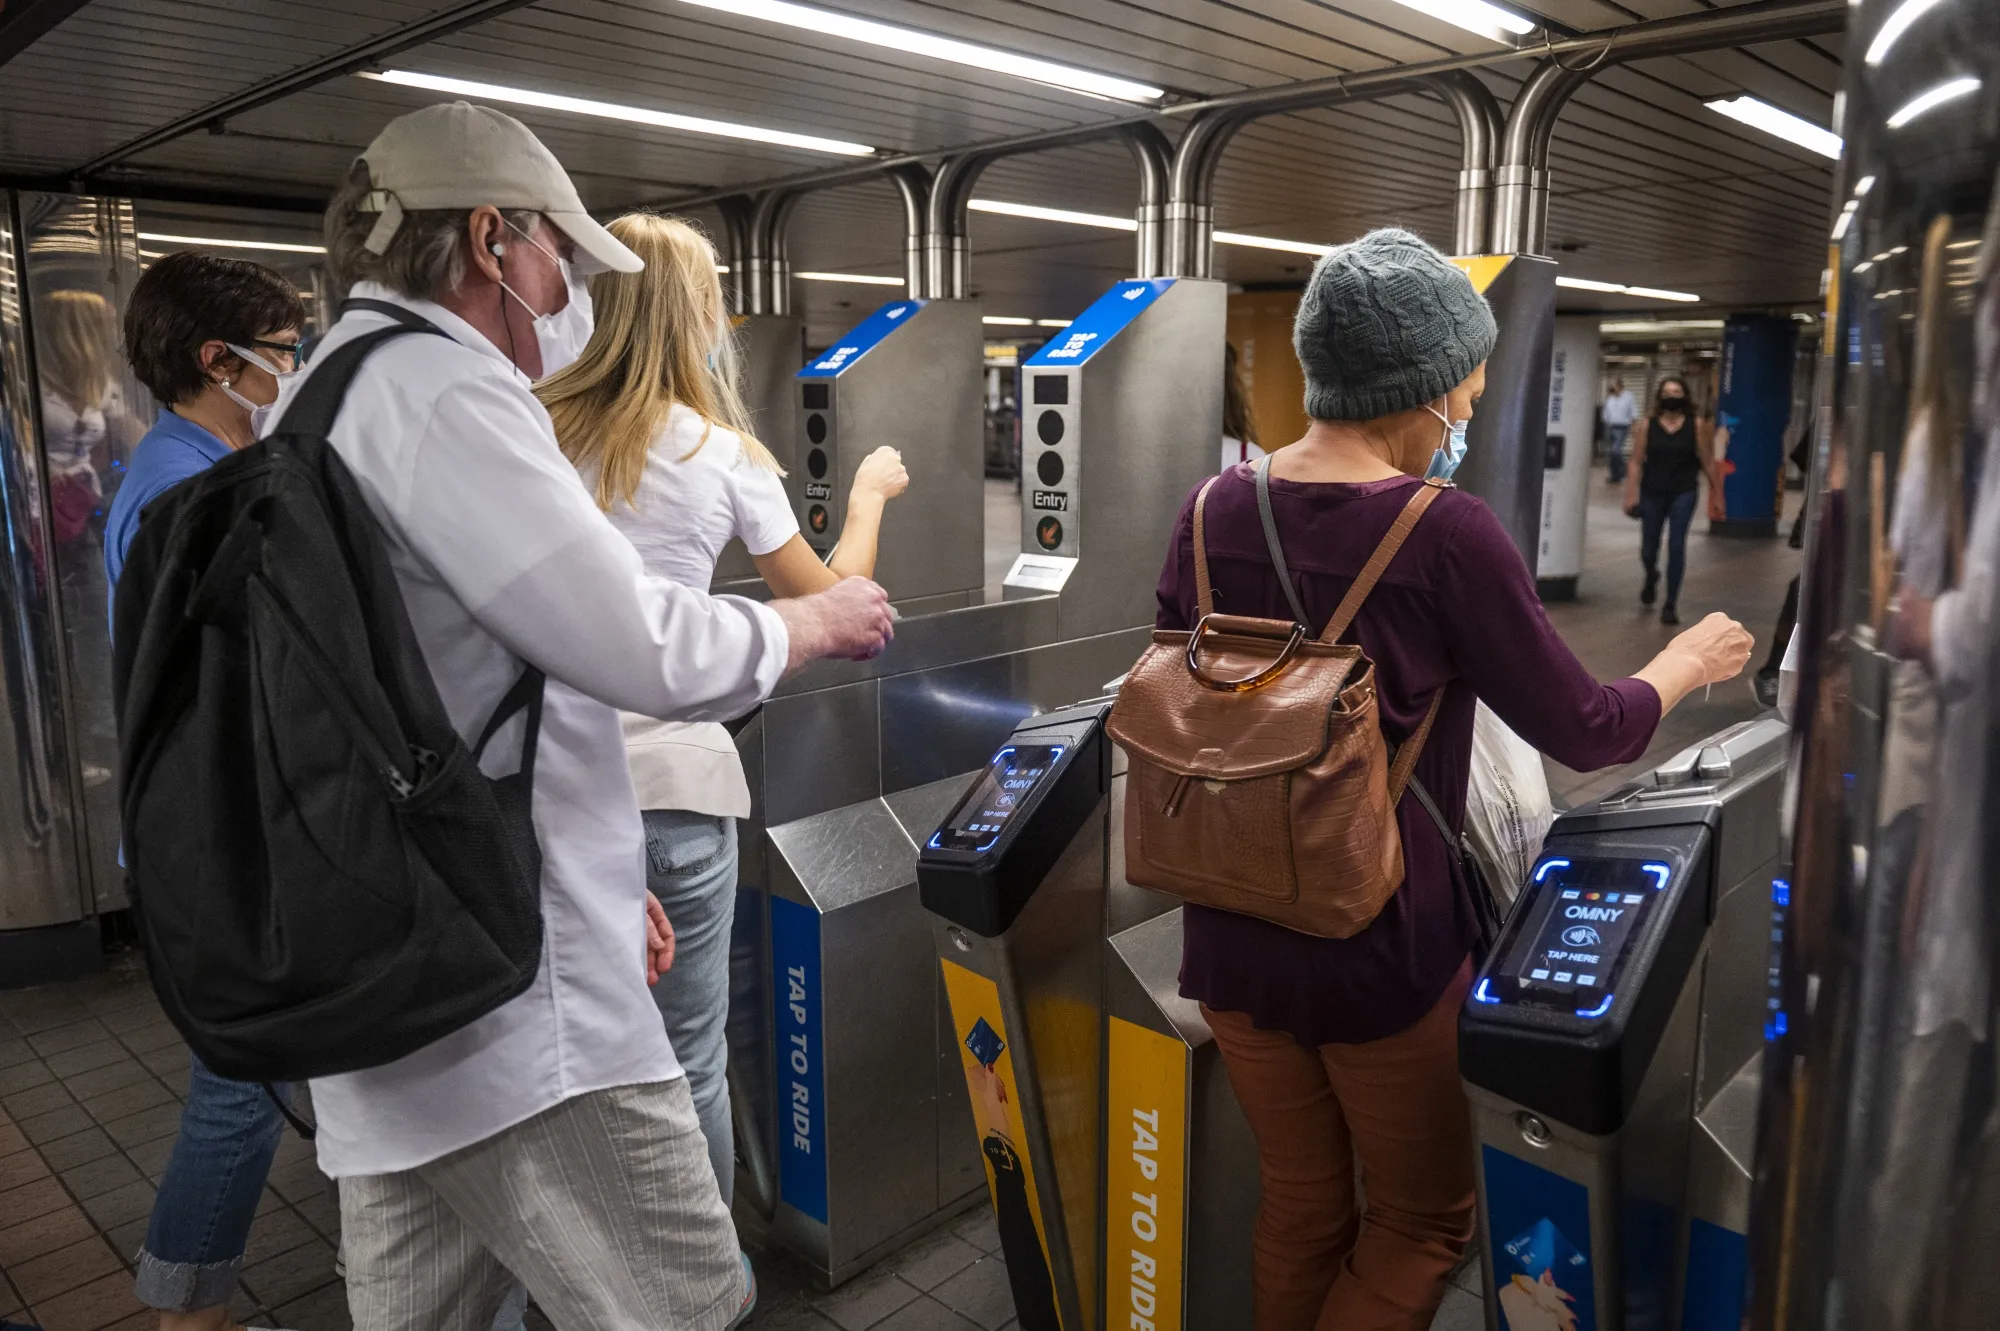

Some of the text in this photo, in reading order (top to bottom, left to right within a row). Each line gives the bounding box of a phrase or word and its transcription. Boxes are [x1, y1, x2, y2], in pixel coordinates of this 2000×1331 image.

[1070, 333, 1098, 341] TAP
[1063, 341, 1085, 350] TO
[1047, 349, 1083, 358] RIDE
[806, 483, 831, 500] Entry
[1035, 492, 1067, 511] Entry
[1003, 779, 1035, 789] OMNY
[1564, 905, 1624, 922] OMNY
[1547, 950, 1600, 964] TAP HERE
[787, 965, 812, 1155] TAP TO RIDE
[1130, 1108, 1159, 1331] TAP TO RIDE
